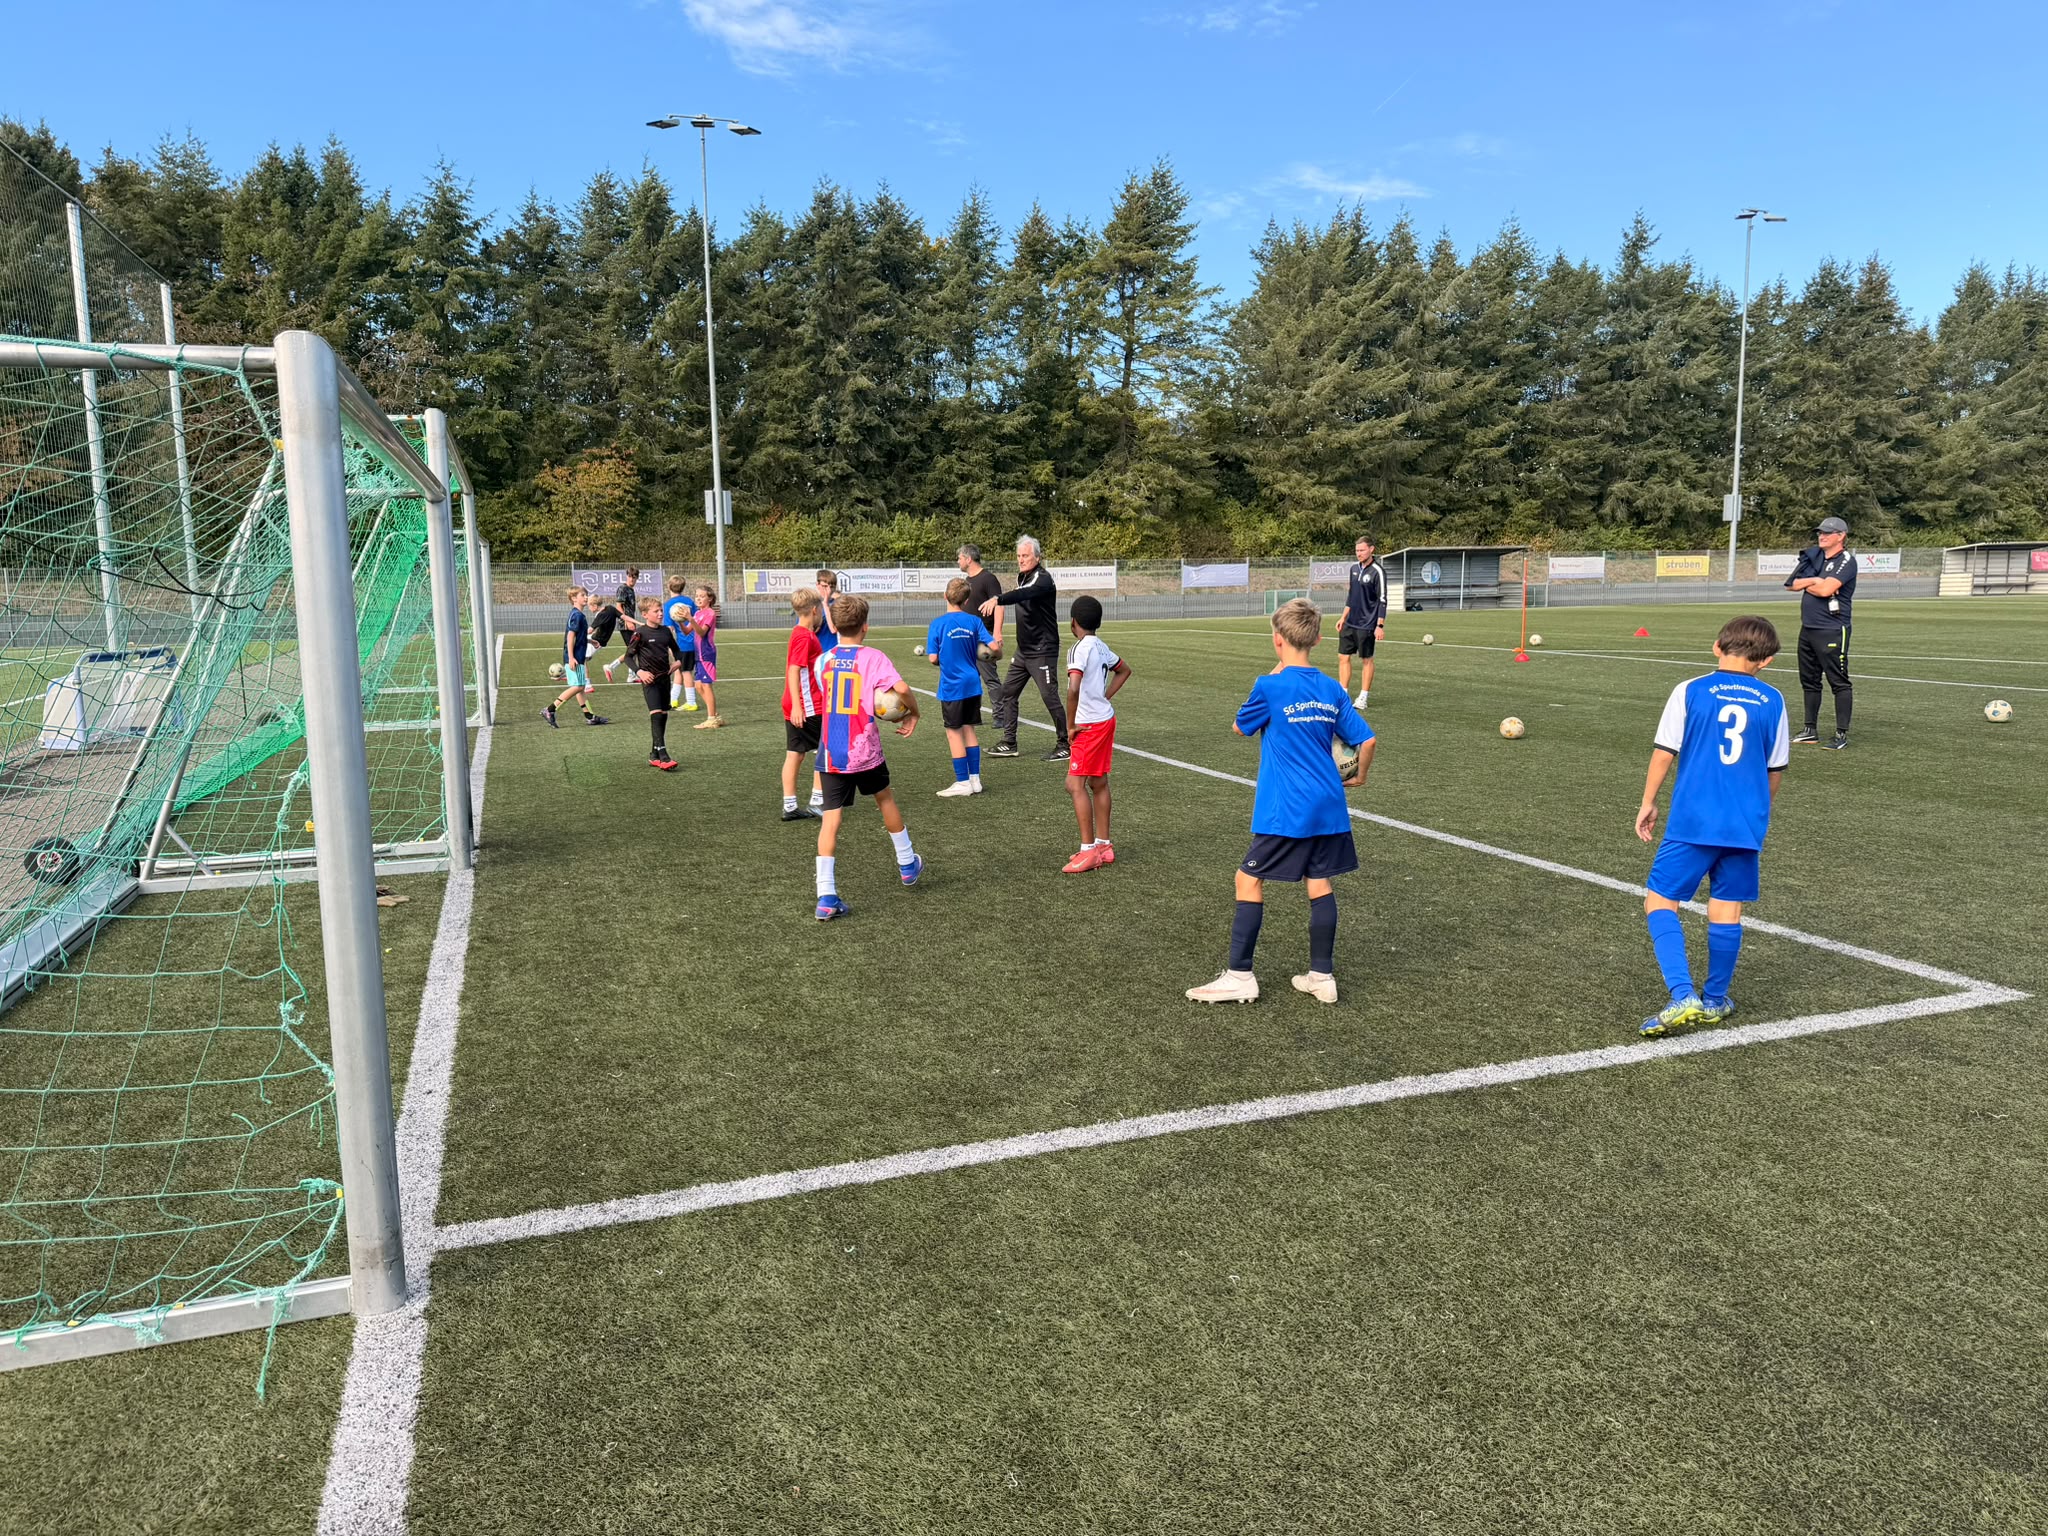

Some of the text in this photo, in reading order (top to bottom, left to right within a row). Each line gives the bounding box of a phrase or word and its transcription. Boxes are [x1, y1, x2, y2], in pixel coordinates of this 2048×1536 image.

[602, 573, 652, 584] PELER
[823, 670, 863, 715] 10
[1708, 685, 1720, 694] SG
[1283, 704, 1295, 716] SG
[1717, 704, 1748, 765] 3
